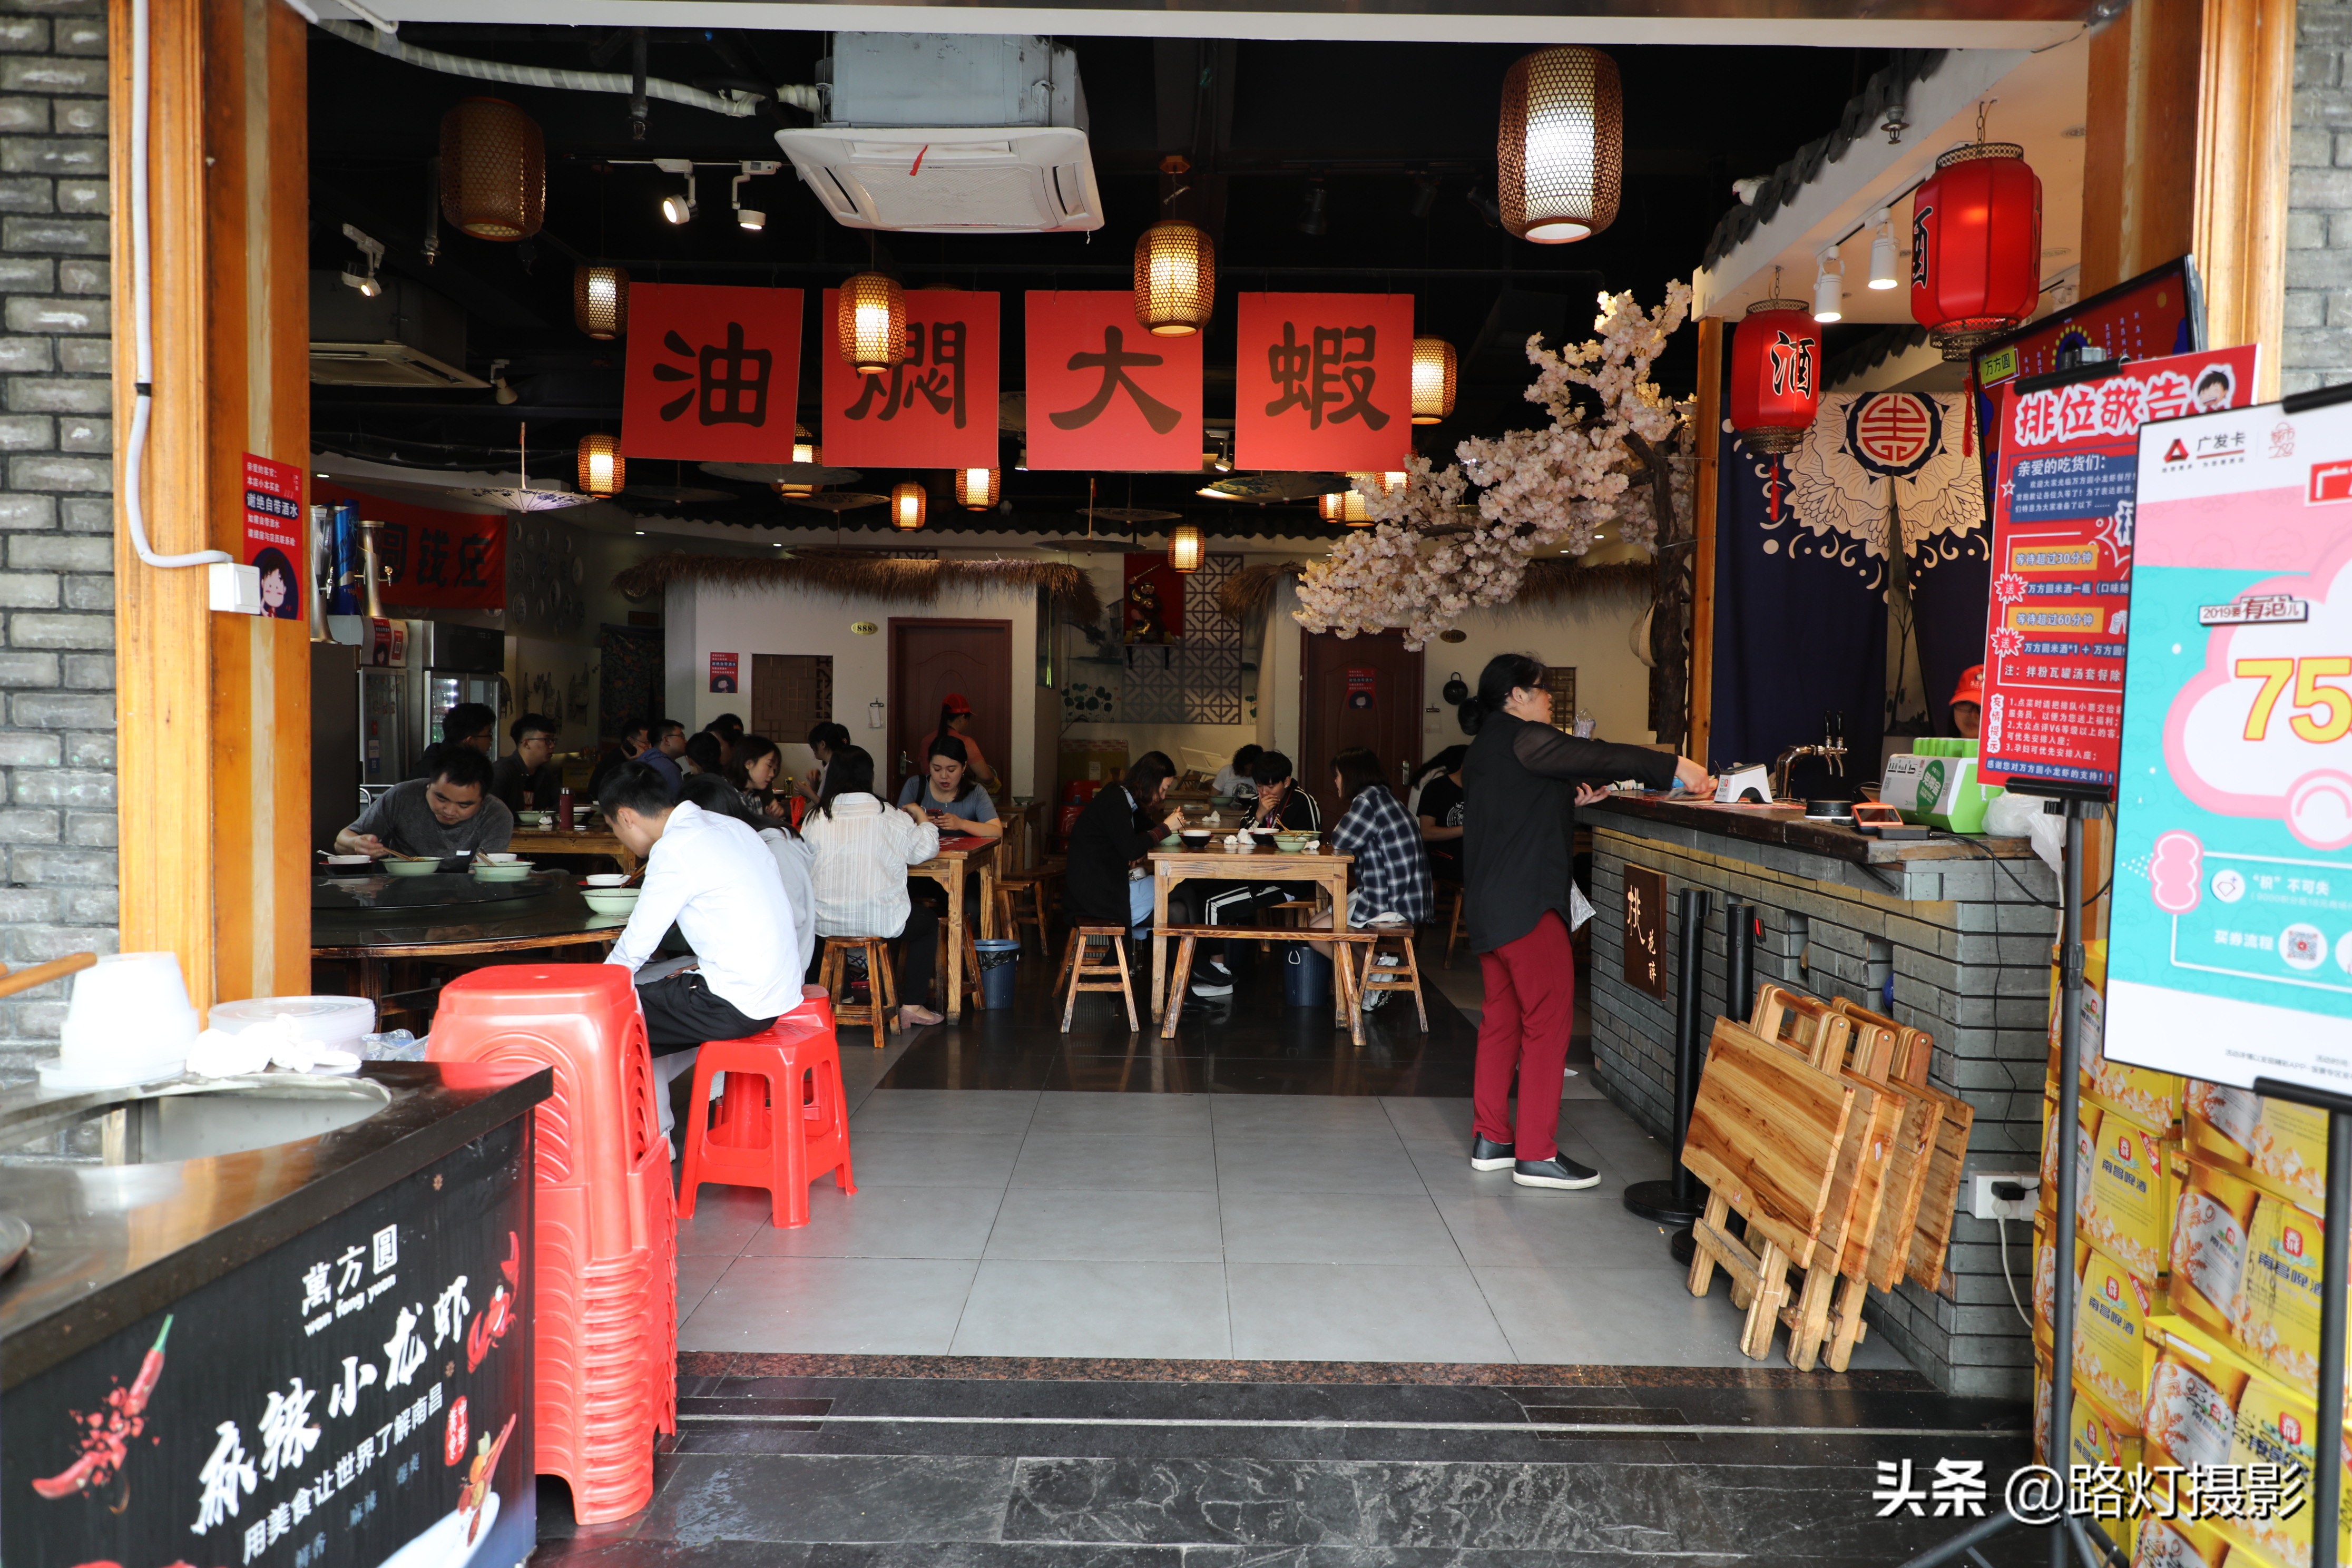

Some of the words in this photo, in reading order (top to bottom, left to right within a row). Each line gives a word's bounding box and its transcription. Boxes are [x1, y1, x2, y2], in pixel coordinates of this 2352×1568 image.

[1770, 331, 1815, 399] 酒
[2015, 371, 2194, 447] 排位敬告
[2197, 431, 2245, 452] 广发卡
[2018, 454, 2106, 476] 亲爱的吃货们:
[247, 493, 298, 517] 谢绝自带酒水
[2016, 552, 2092, 565] 等待超过30分钟
[2005, 583, 2014, 594] 送
[2017, 613, 2093, 626] 等待超过60分钟
[2001, 638, 2010, 649] 送
[2235, 656, 2352, 744] 75
[1990, 694, 2003, 753] 友情提示
[2102, 1159, 2147, 1193] 南昌啤酒
[2259, 1251, 2323, 1297] 南昌啤酒
[304, 1312, 332, 1338] wan
[335, 1292, 365, 1319] fang
[367, 1274, 396, 1304] yuan
[2089, 1296, 2134, 1335] 南昌啤酒
[2074, 1437, 2099, 1470] 南昌啤
[242, 1381, 443, 1566] 用美食让世界了解南昌
